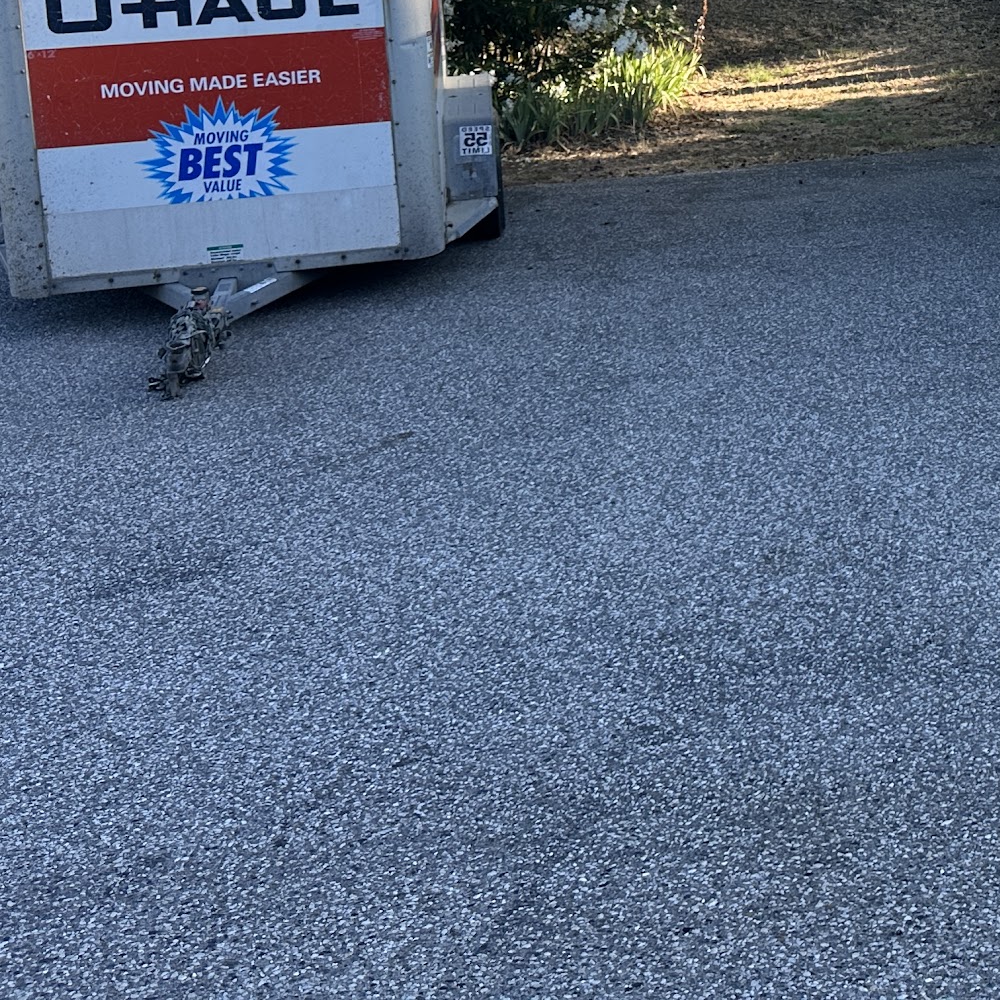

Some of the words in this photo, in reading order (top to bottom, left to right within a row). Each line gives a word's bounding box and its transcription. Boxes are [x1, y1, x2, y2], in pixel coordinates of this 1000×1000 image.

[100, 78, 184, 99] MOVING
[189, 73, 248, 92] MADE
[252, 69, 321, 88] EASIER
[194, 129, 249, 145] MOVING
[178, 143, 263, 181] BEST
[203, 178, 242, 193] VALUE
